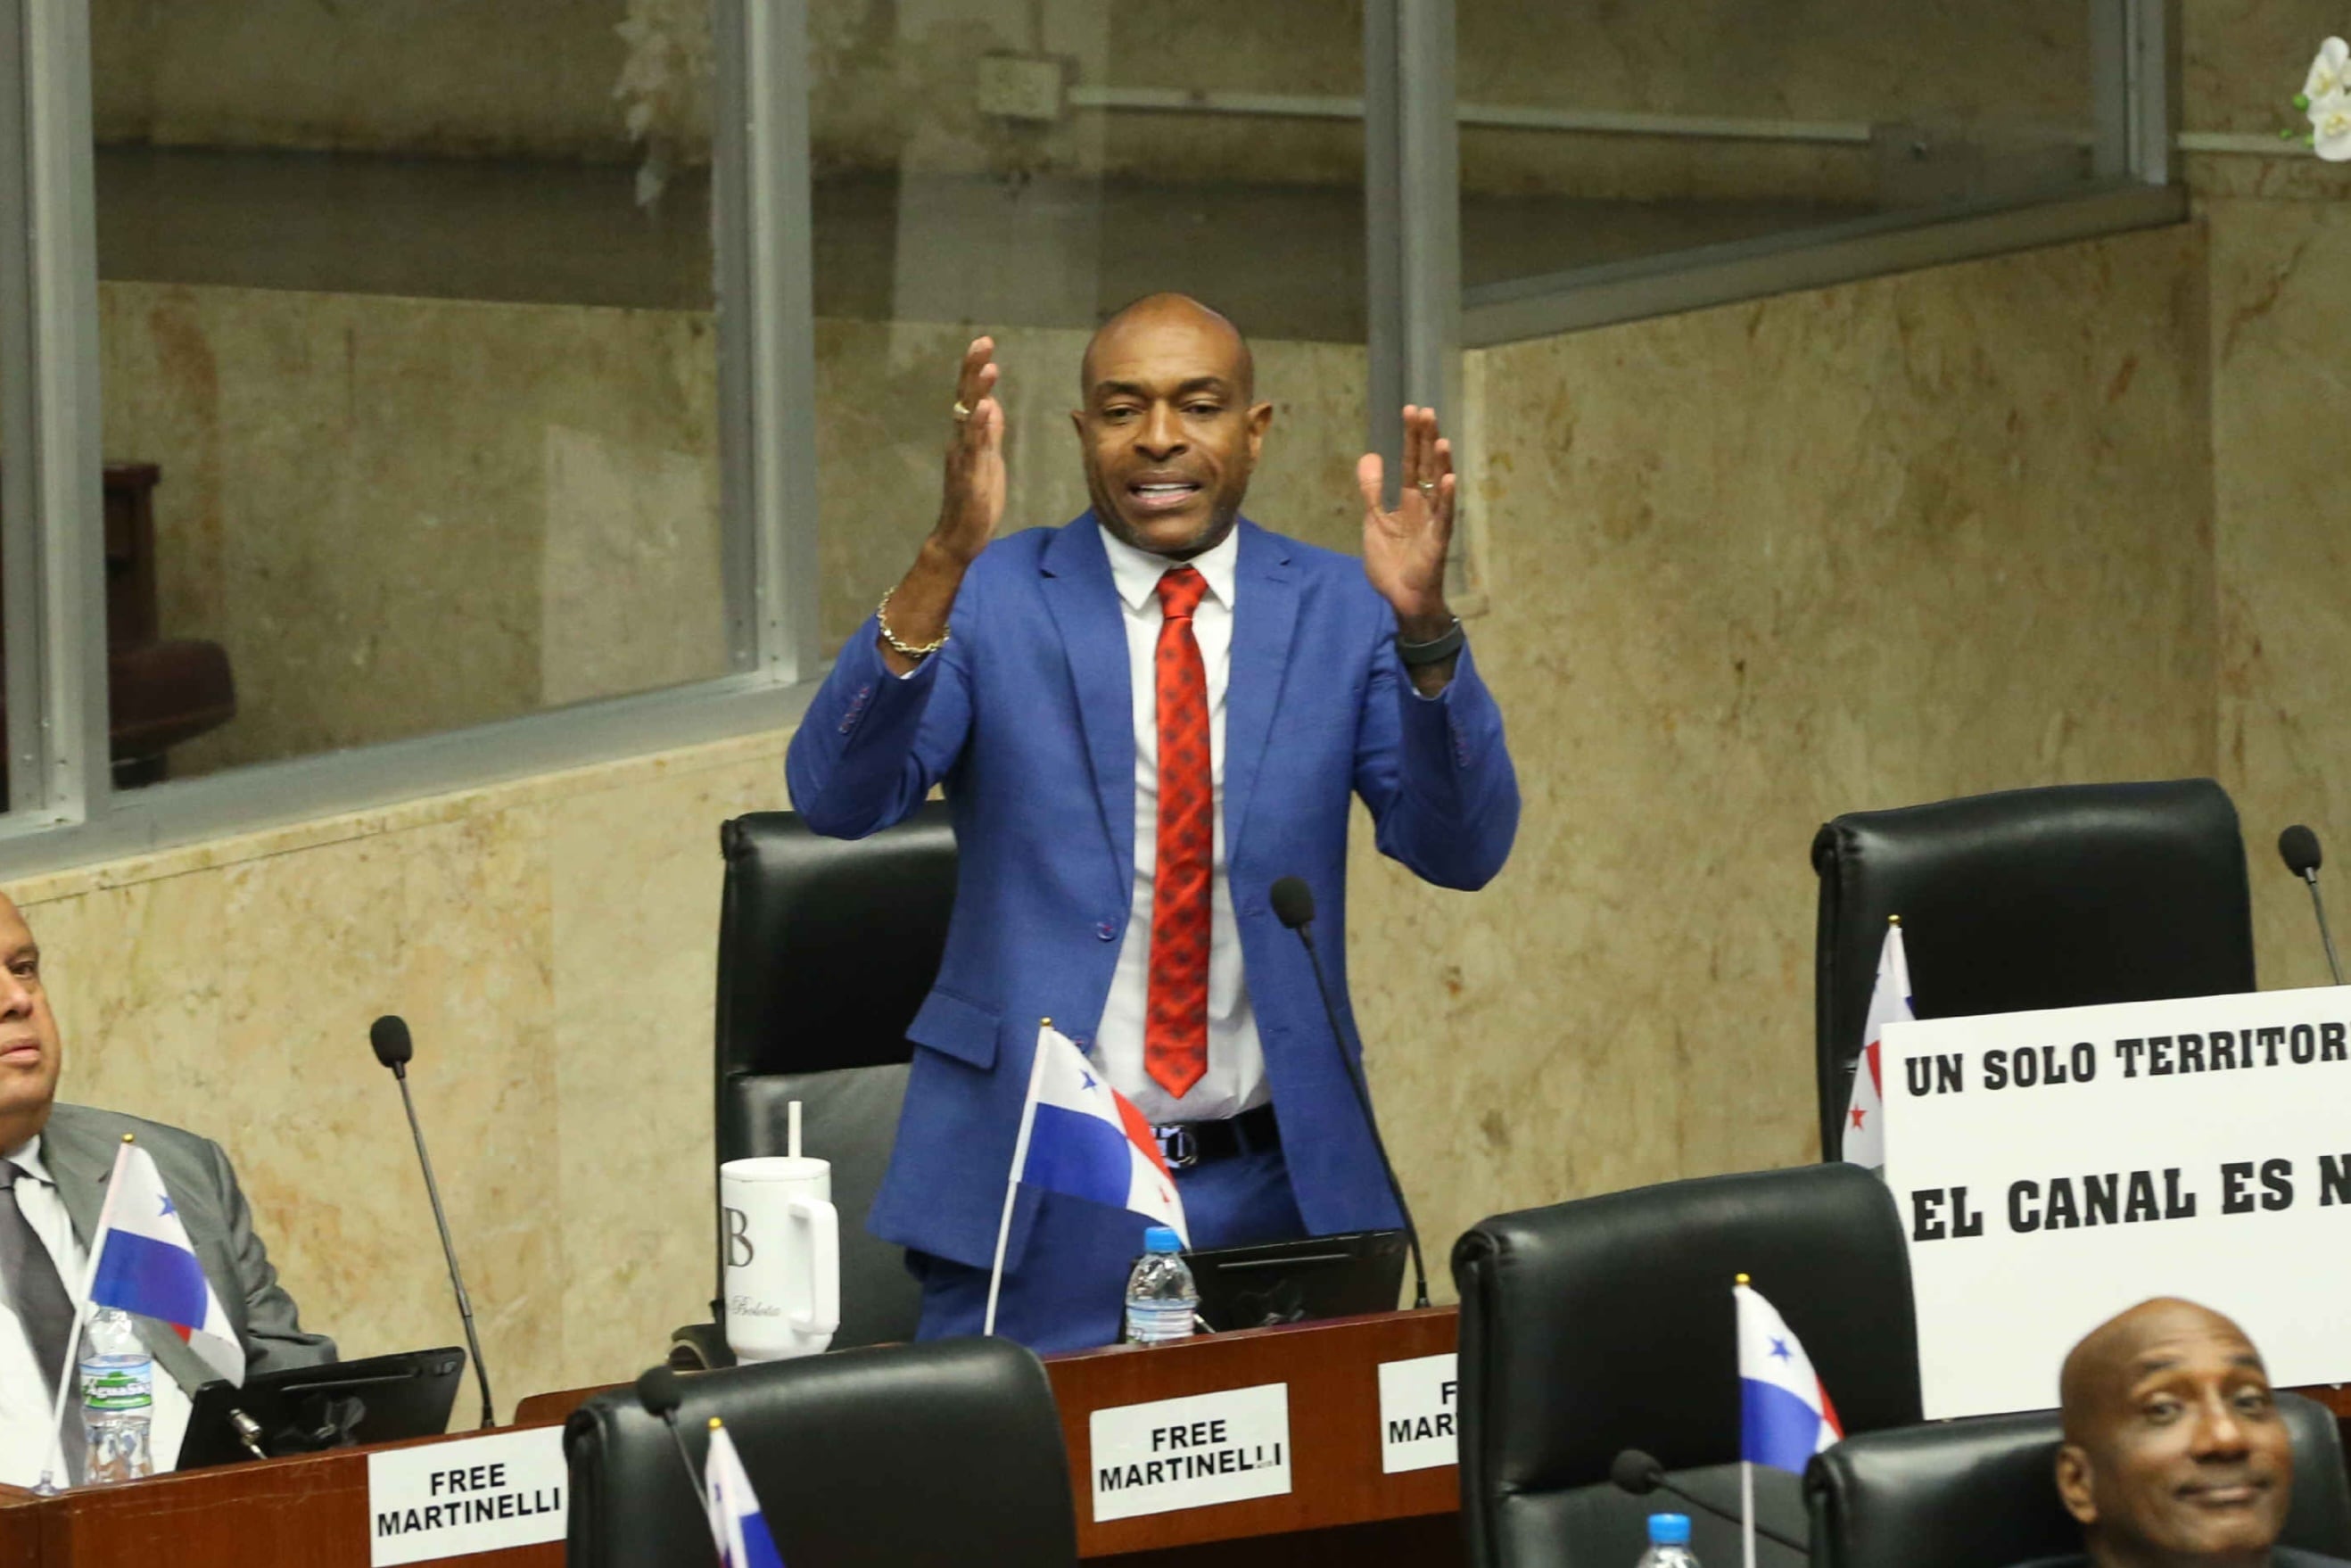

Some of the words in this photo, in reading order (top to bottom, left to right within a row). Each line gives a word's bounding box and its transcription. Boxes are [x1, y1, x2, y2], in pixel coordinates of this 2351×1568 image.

[1905, 1052, 1963, 1097] UN
[1983, 1042, 2096, 1091] SOLO
[2115, 1021, 2351, 1078] TERRITOR
[1911, 1186, 1984, 1242] EL
[2008, 1168, 2197, 1234] CANAL
[2221, 1158, 2294, 1215] ES
[2318, 1153, 2351, 1207] N
[1441, 1381, 1457, 1405] F
[1151, 1419, 1227, 1452] FREE
[1389, 1413, 1457, 1444] MAR
[430, 1463, 507, 1497] FREE
[1099, 1442, 1282, 1492] MARTINELLI
[377, 1487, 560, 1538] MARTINELLI
